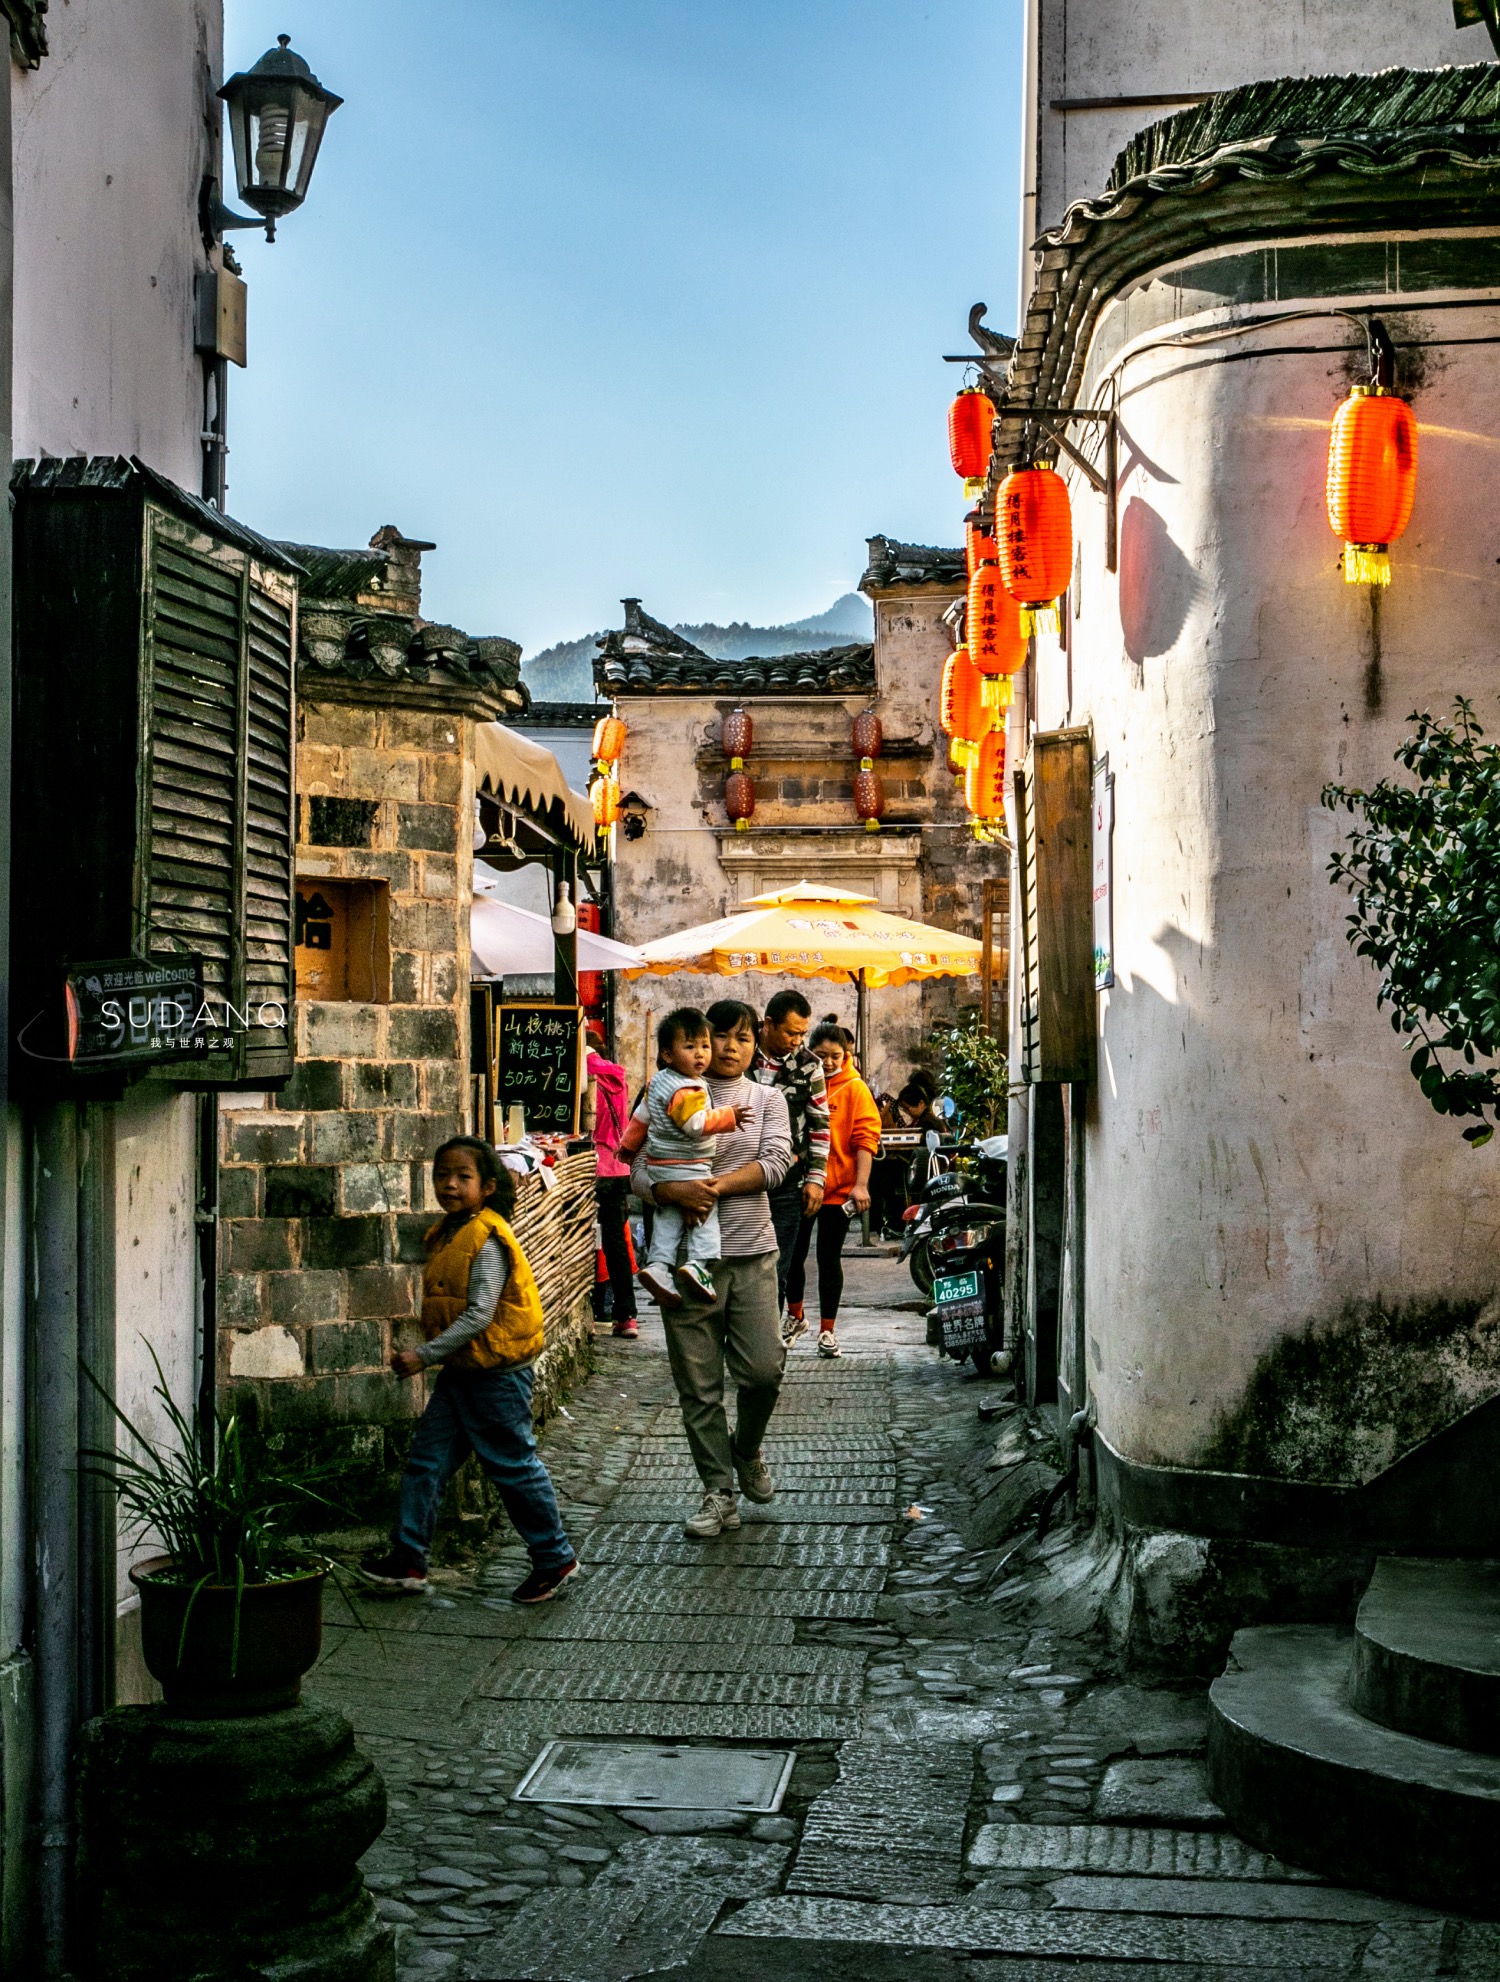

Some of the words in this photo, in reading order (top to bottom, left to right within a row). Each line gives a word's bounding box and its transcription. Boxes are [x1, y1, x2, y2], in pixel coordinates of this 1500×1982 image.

[103, 971, 144, 988] 欢迎光临
[145, 967, 196, 984] welcome
[509, 1039, 567, 1068] 新货上市
[930, 1184, 960, 1196] HONDA
[939, 1284, 973, 1300] 40295
[942, 1315, 985, 1334] 世界名牌
